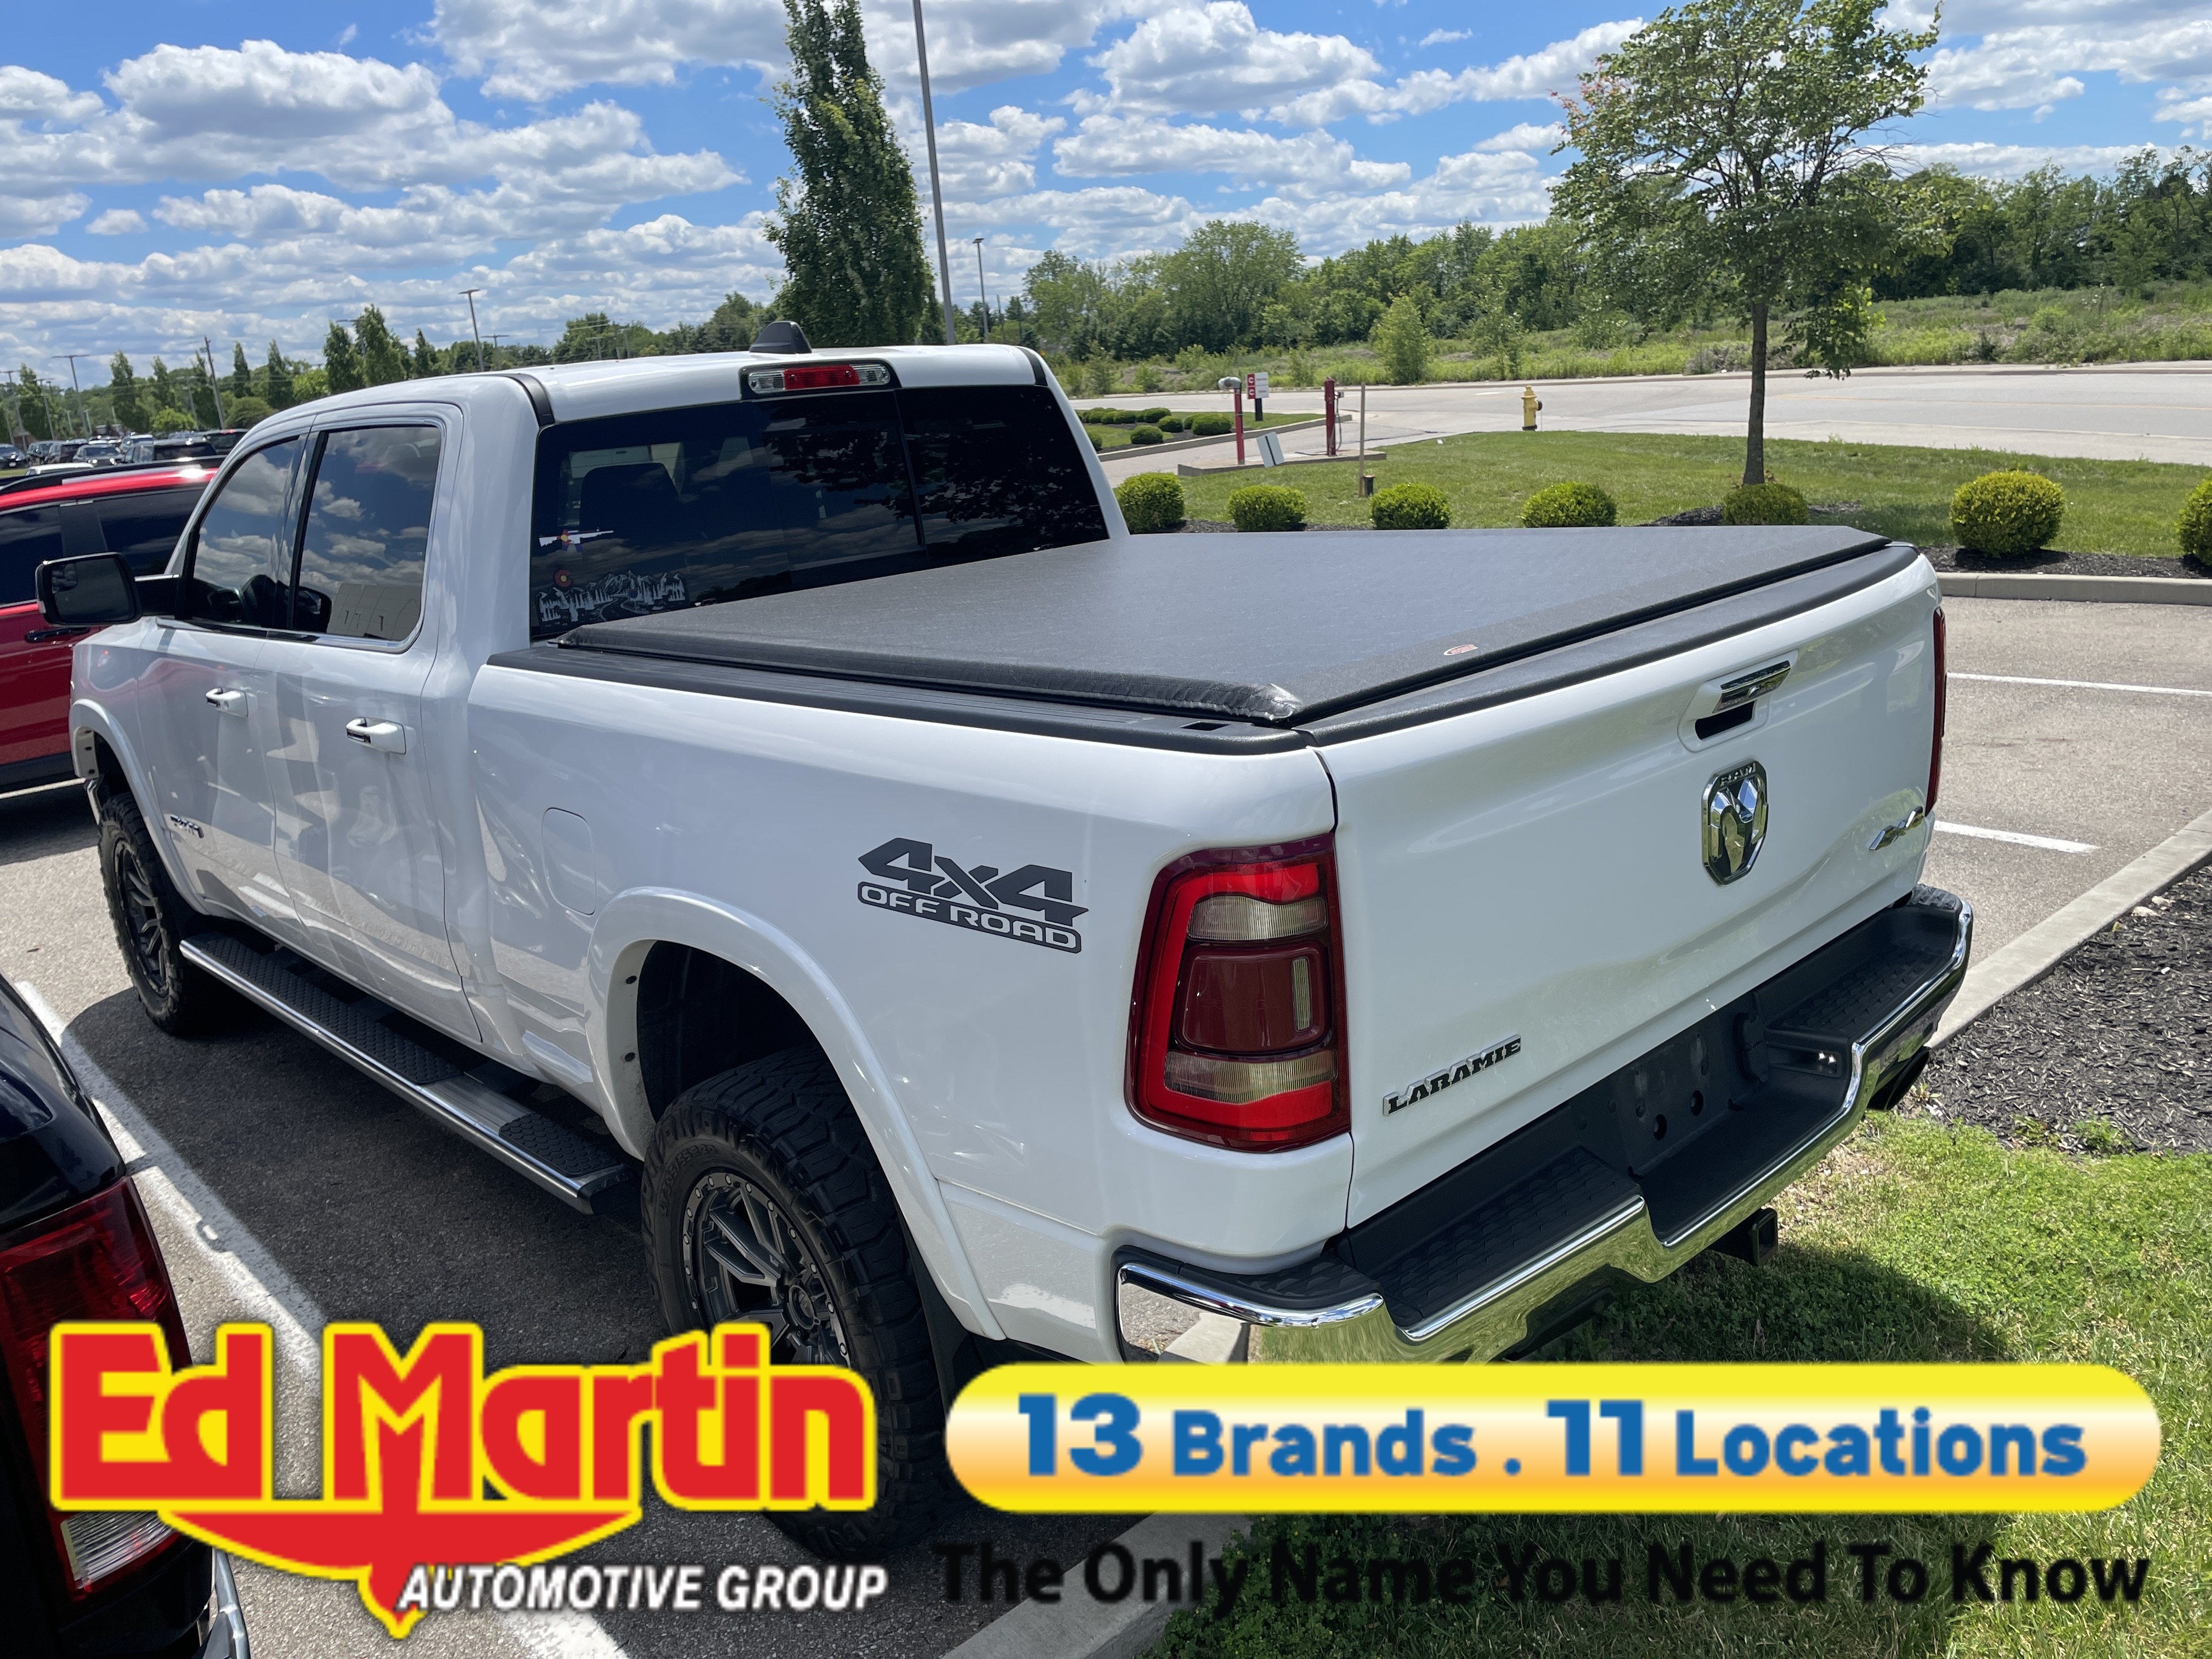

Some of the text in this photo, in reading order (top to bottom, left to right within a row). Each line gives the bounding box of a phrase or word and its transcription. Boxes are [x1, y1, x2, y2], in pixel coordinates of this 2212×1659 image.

[1719, 762, 1756, 787] RAM
[861, 884, 1077, 949] OFF ROAD
[1383, 1034, 1521, 1116] LARAMIE
